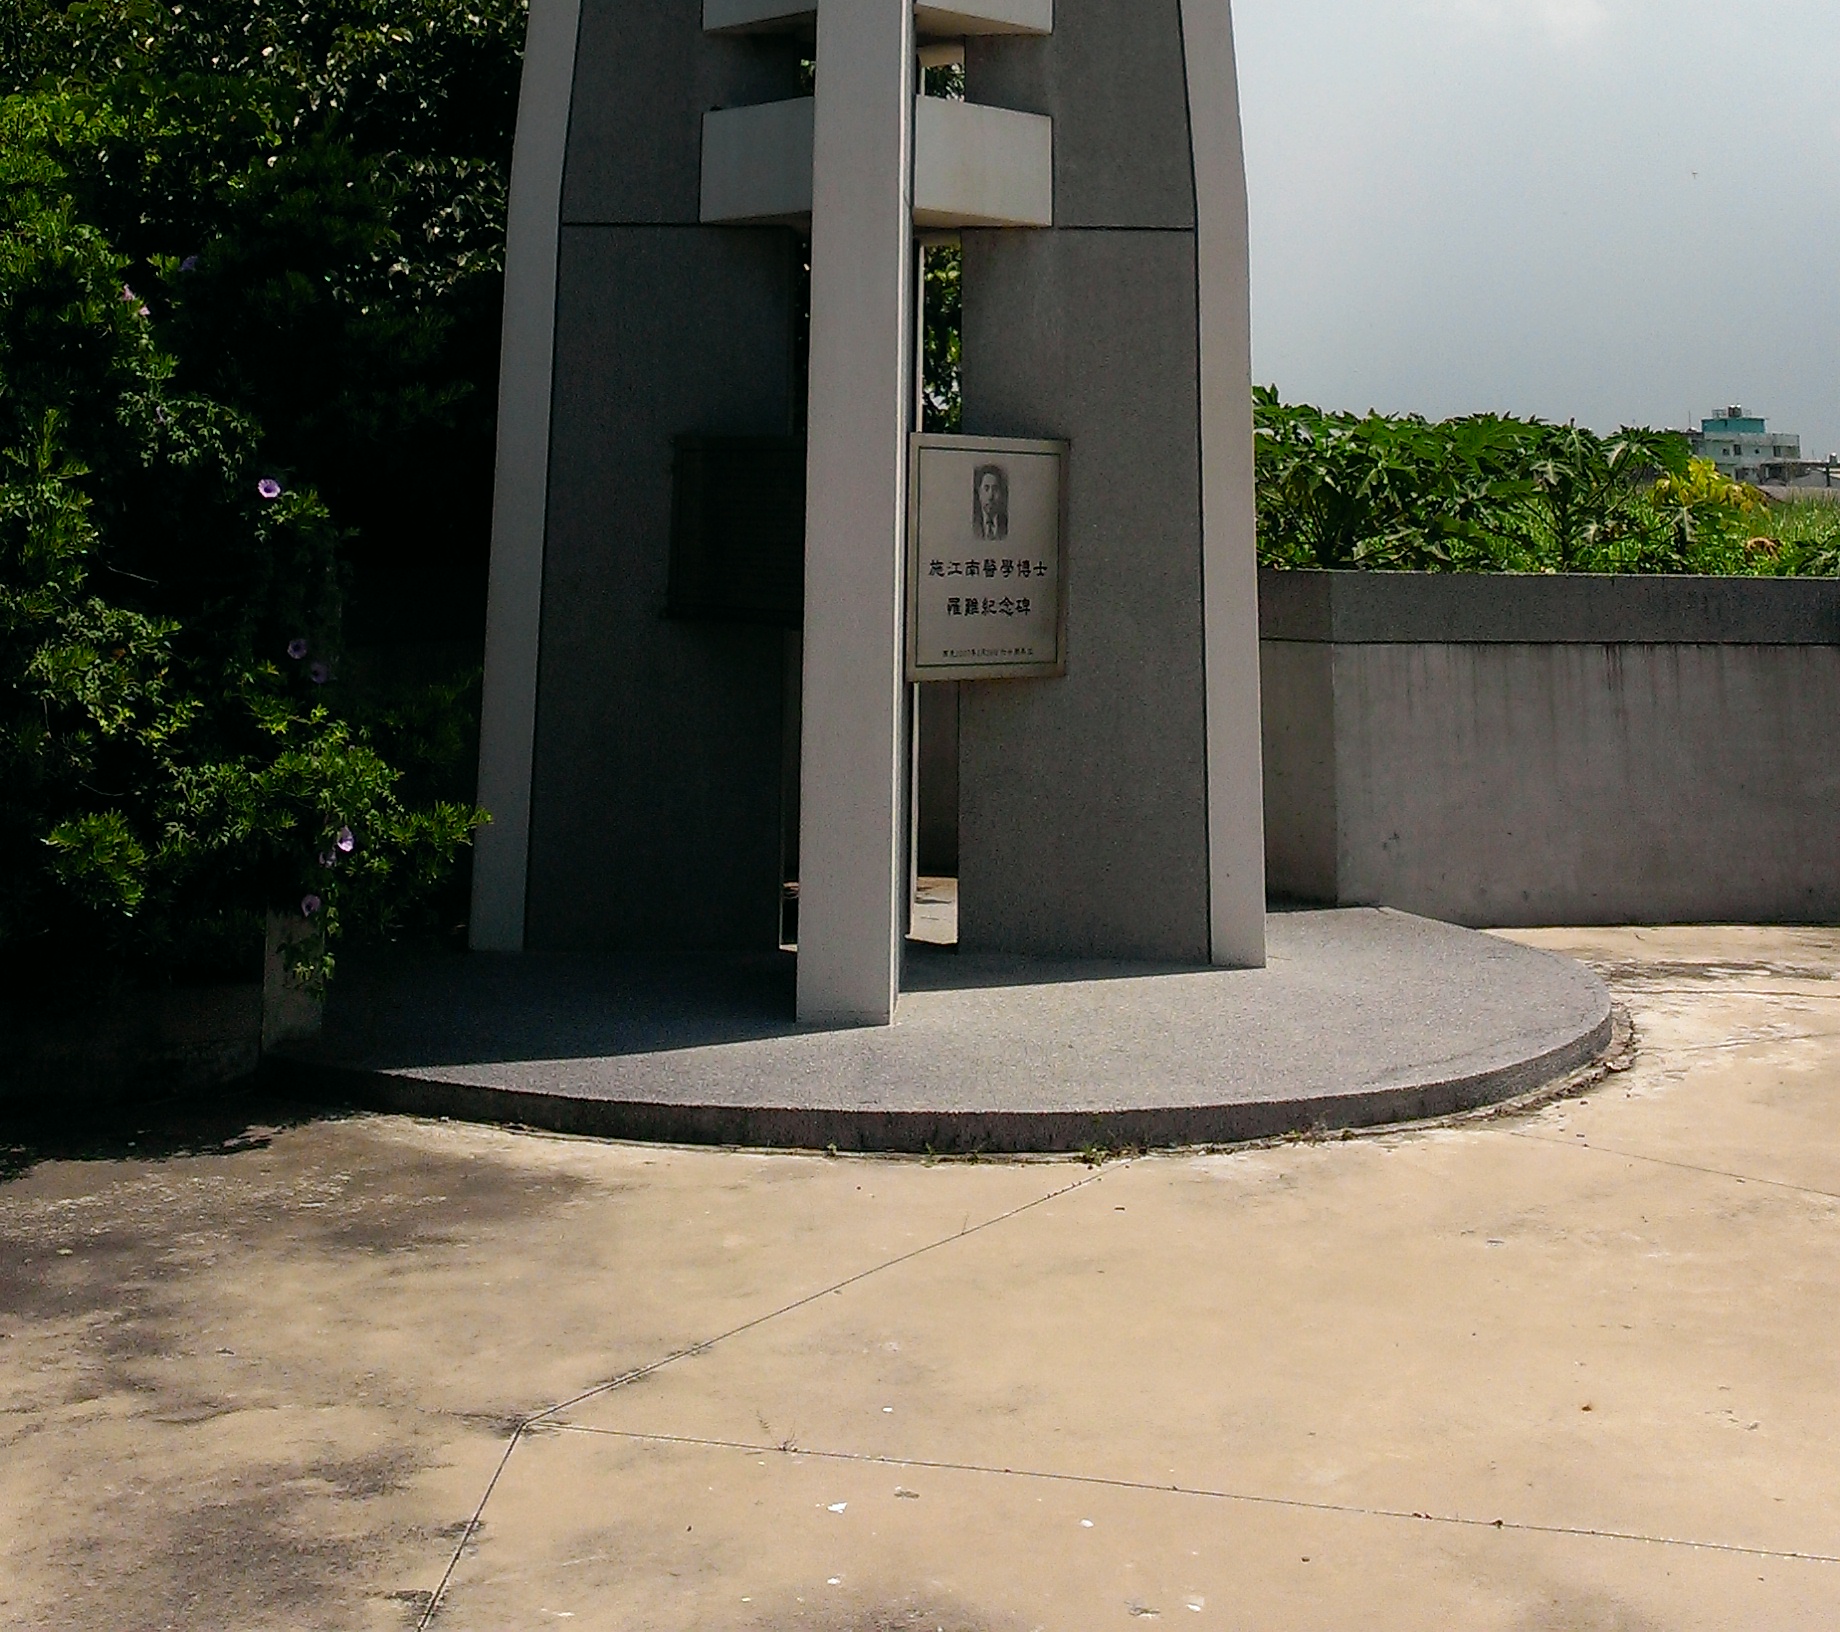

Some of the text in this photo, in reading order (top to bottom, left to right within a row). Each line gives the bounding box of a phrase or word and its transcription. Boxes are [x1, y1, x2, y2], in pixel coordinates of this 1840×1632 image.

[928, 559, 1048, 578] 施江南醫學博士
